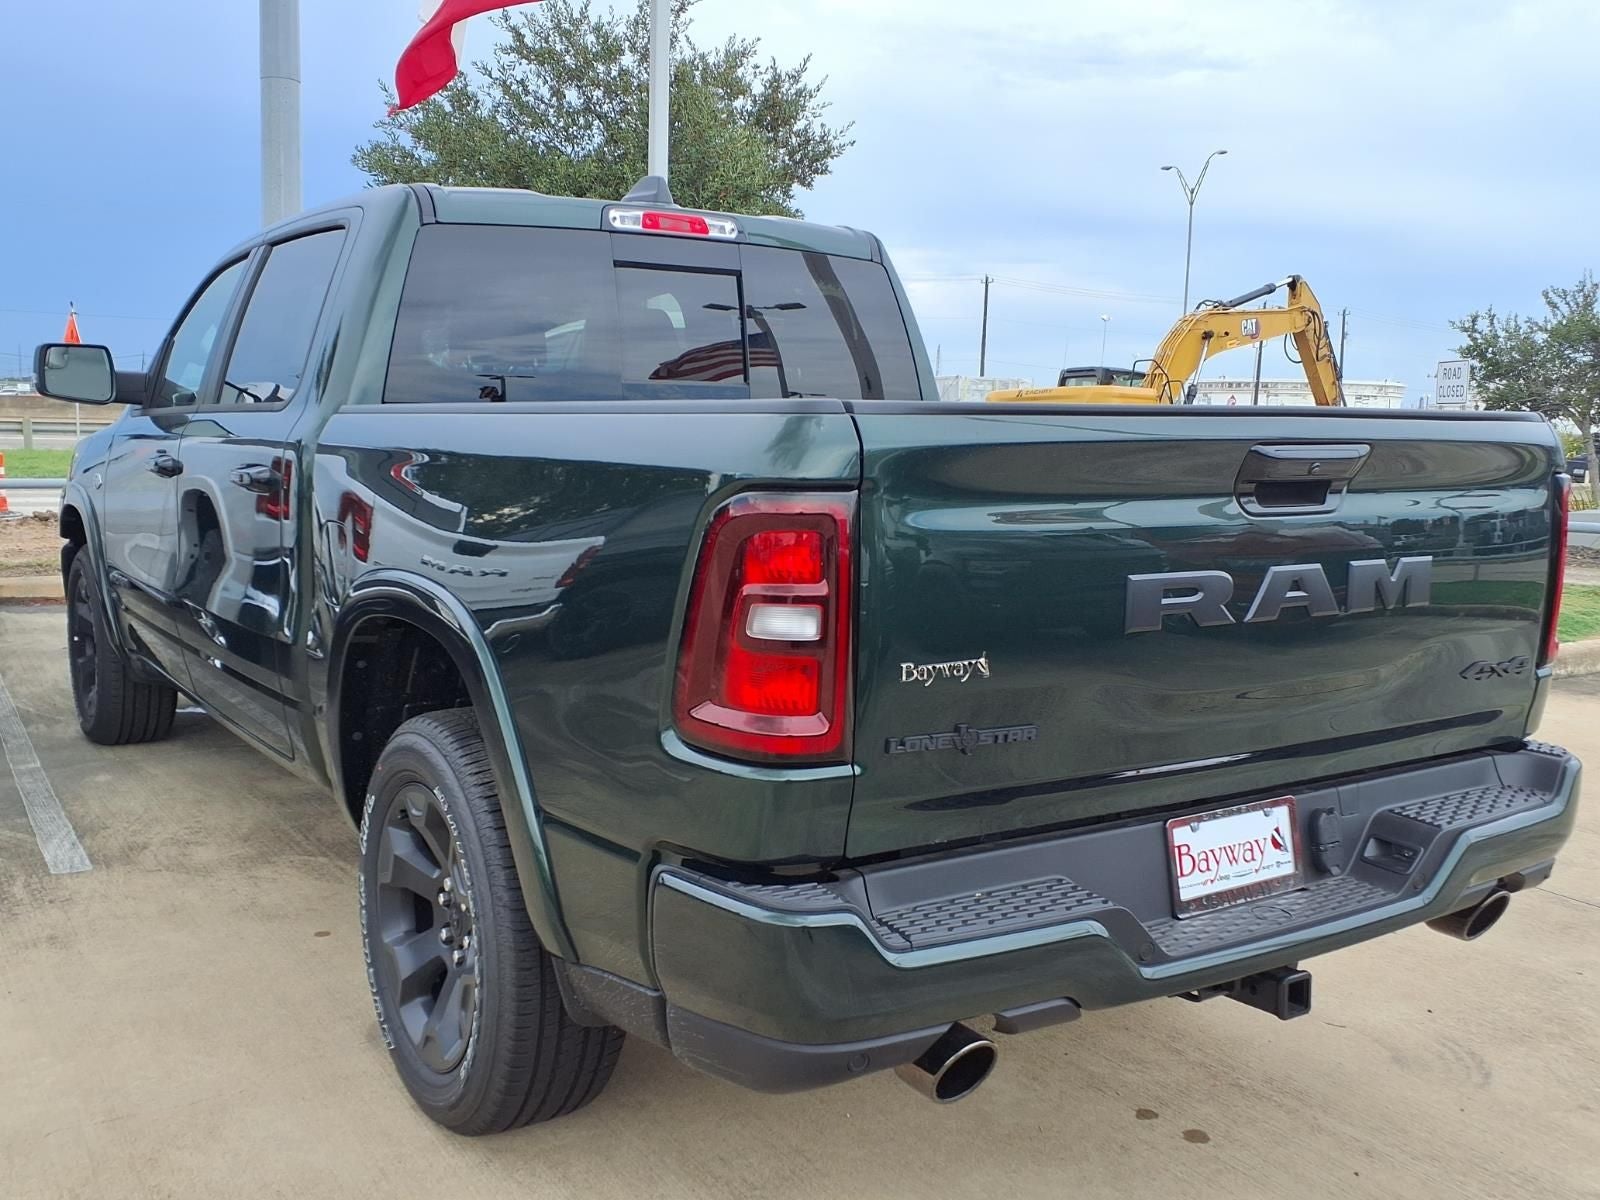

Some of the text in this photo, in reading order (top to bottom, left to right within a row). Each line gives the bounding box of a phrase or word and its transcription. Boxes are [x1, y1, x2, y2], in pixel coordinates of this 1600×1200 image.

[1242, 319, 1257, 336] CAT
[1442, 367, 1462, 380] ROAD
[1438, 385, 1465, 398] CLOSED
[1125, 555, 1433, 635] RAM
[899, 657, 977, 687] Bayway
[884, 723, 1039, 754] LONE STAR
[1175, 837, 1268, 884] Bayway
